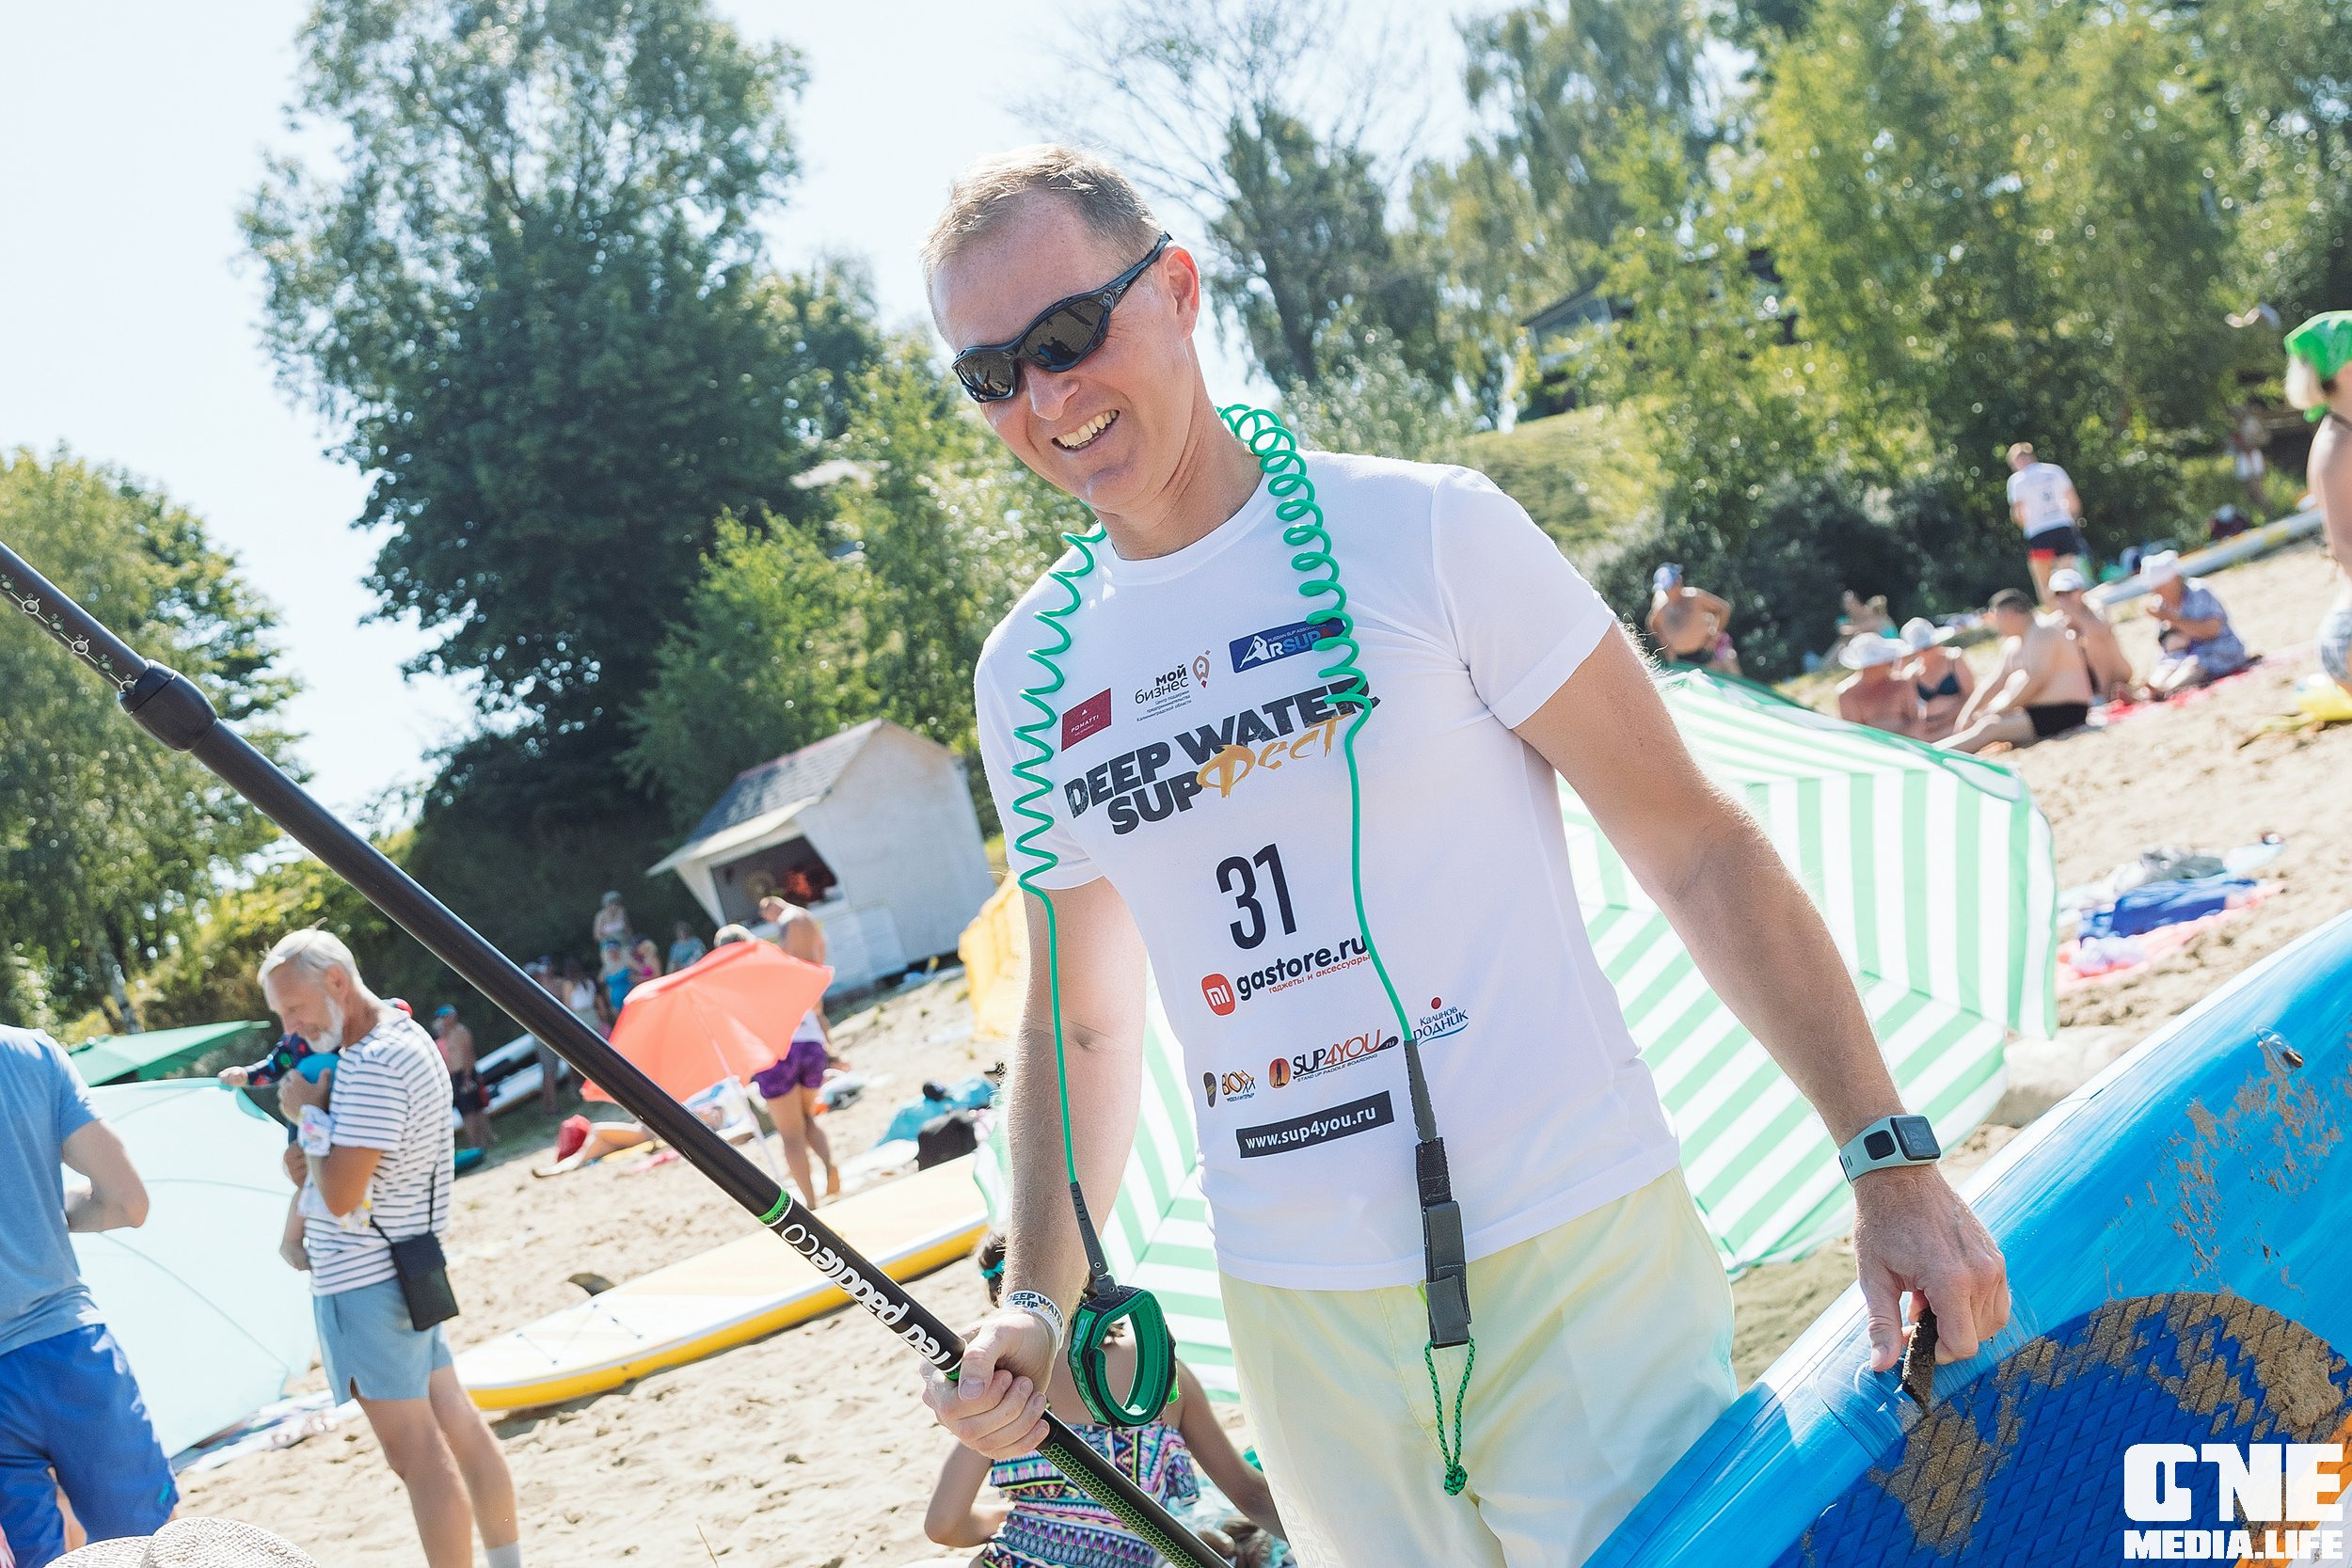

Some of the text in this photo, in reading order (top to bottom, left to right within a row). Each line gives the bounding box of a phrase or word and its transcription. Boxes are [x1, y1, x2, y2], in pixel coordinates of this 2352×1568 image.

[1135, 676, 1189, 705] бизнес
[1063, 677, 1380, 818] DEEP WATER
[1107, 771, 1202, 835] SUP
[1216, 843, 1297, 950] 31
[1236, 935, 1368, 1001] gastore.ru
[1268, 977, 1305, 993] гаджеты
[1315, 955, 1371, 978] аксессуары
[1246, 1106, 1376, 1149] www.sup4you.ru
